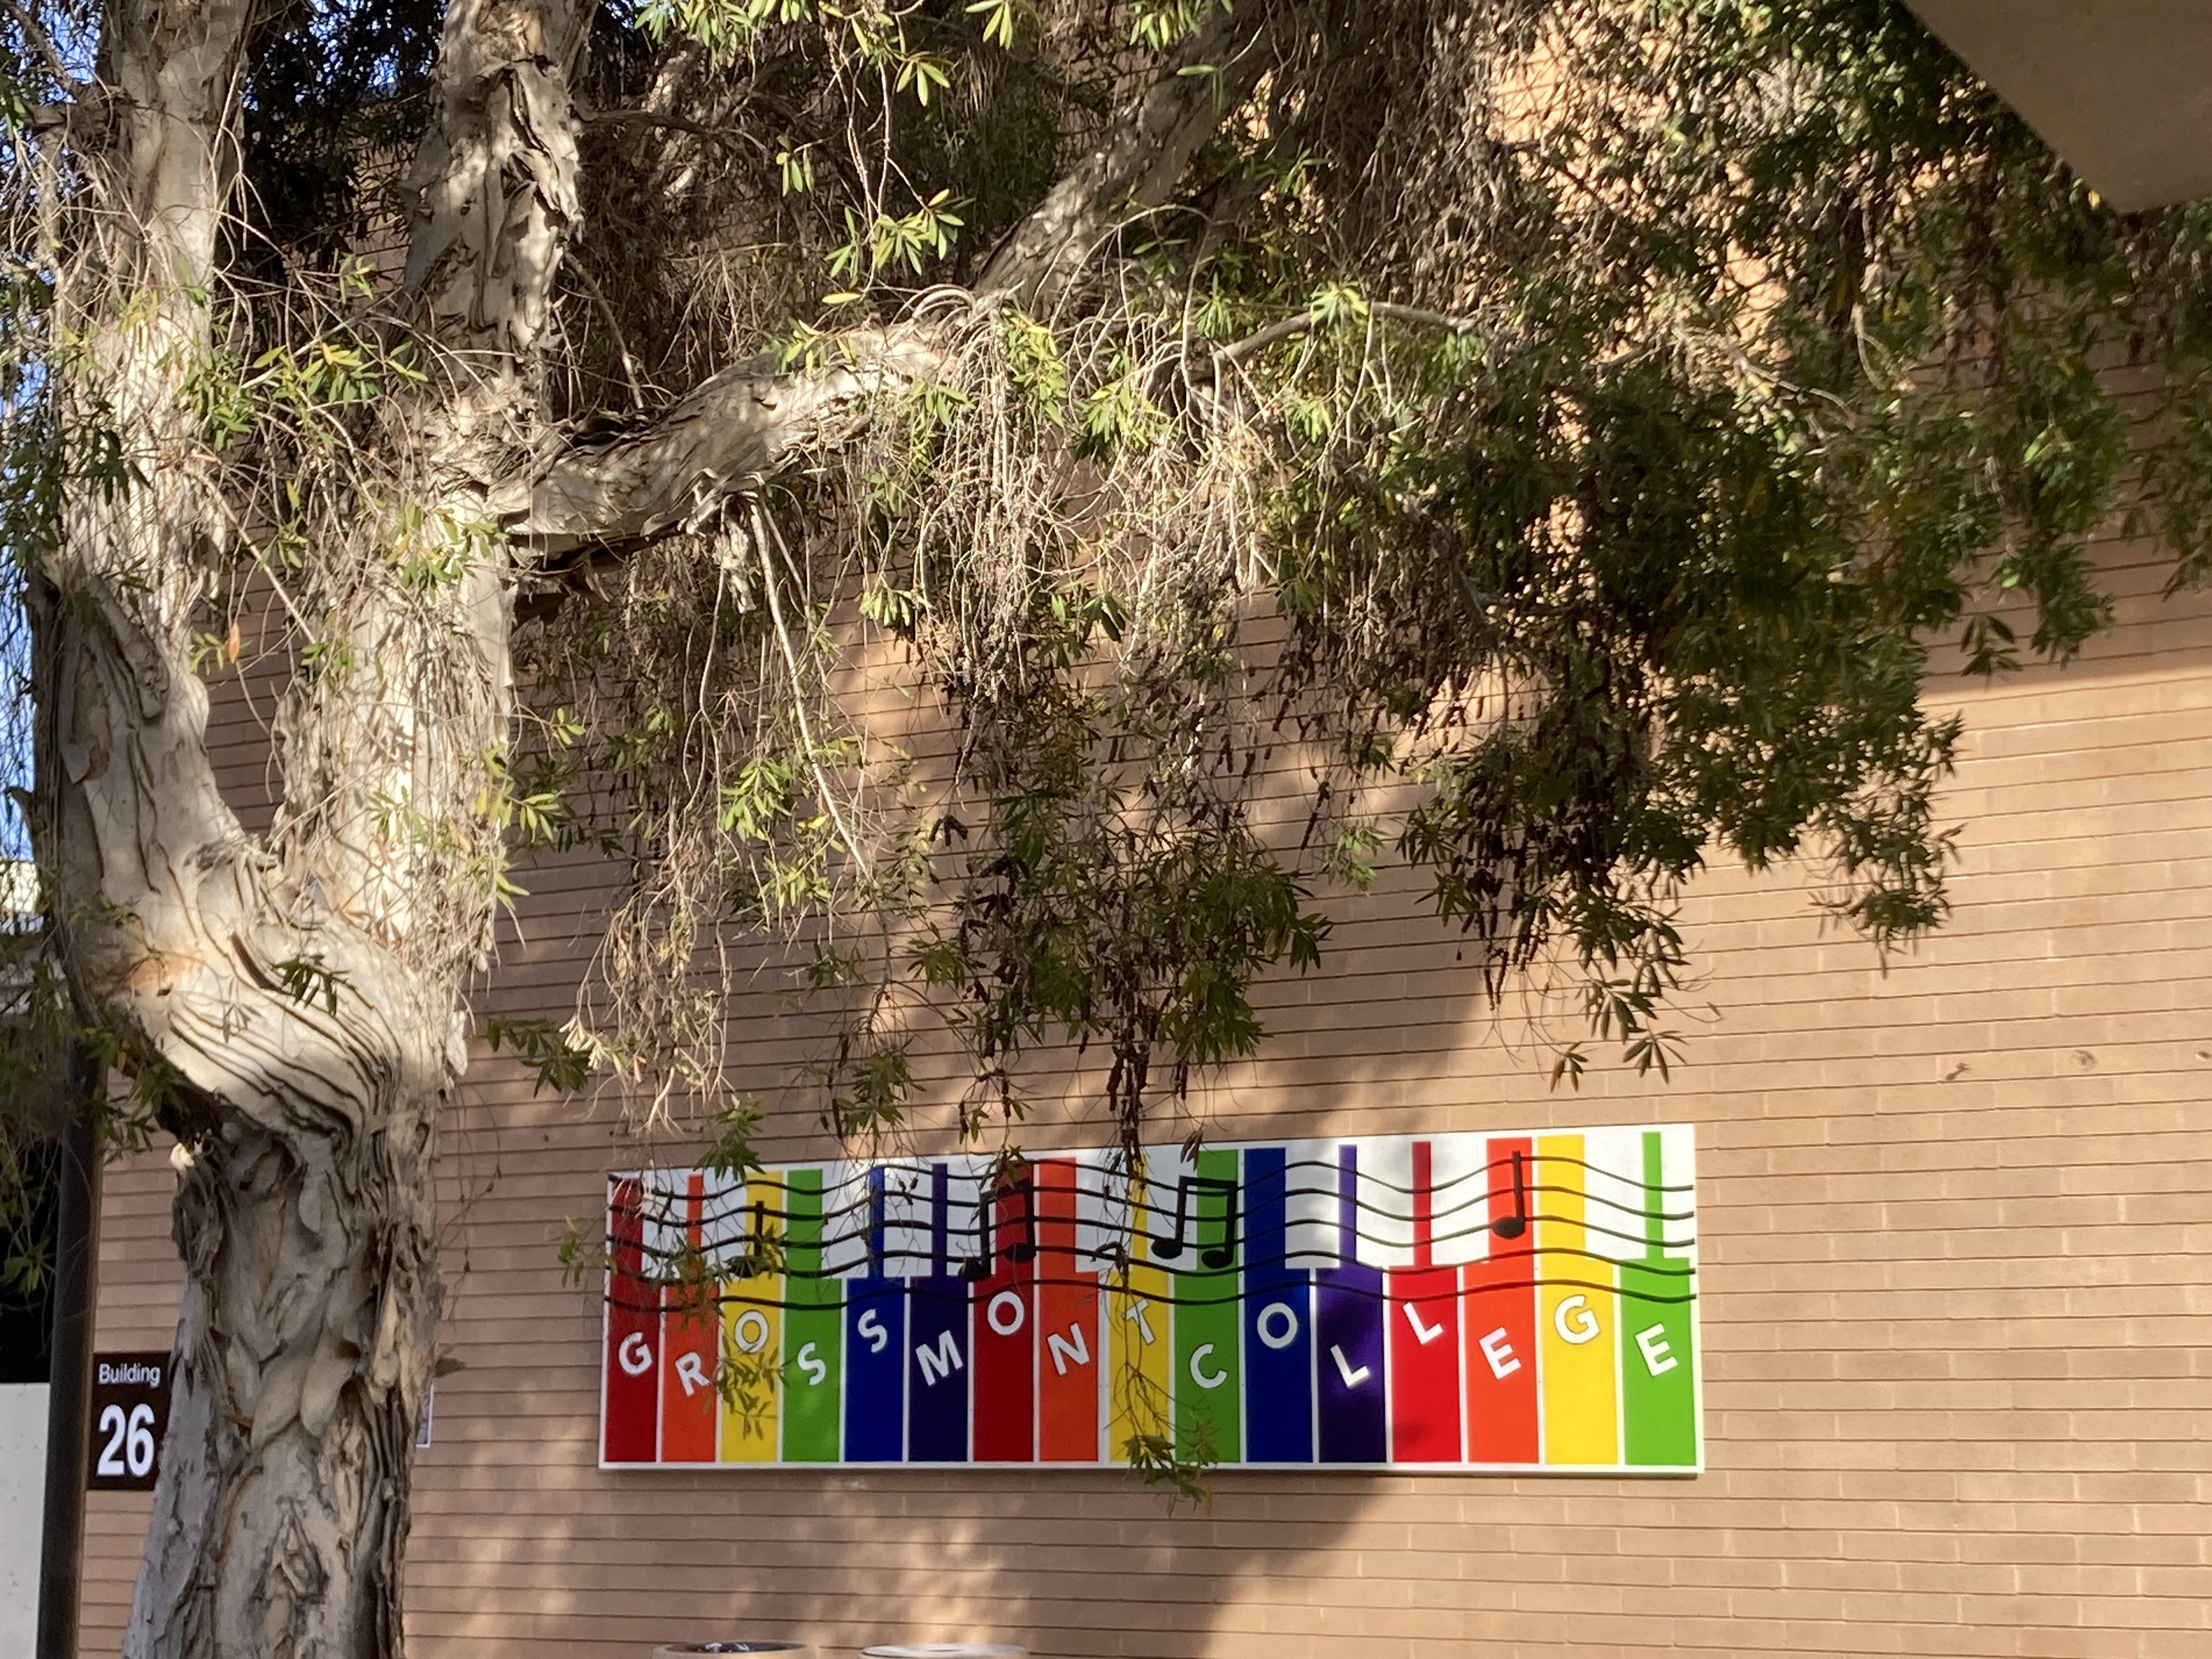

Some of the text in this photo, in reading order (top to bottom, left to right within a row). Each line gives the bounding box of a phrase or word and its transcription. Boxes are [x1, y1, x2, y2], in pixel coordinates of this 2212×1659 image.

[98, 1363, 160, 1387] Building
[619, 1291, 1678, 1396] GROSSMONT COLLEGE
[97, 1404, 155, 1477] 26
